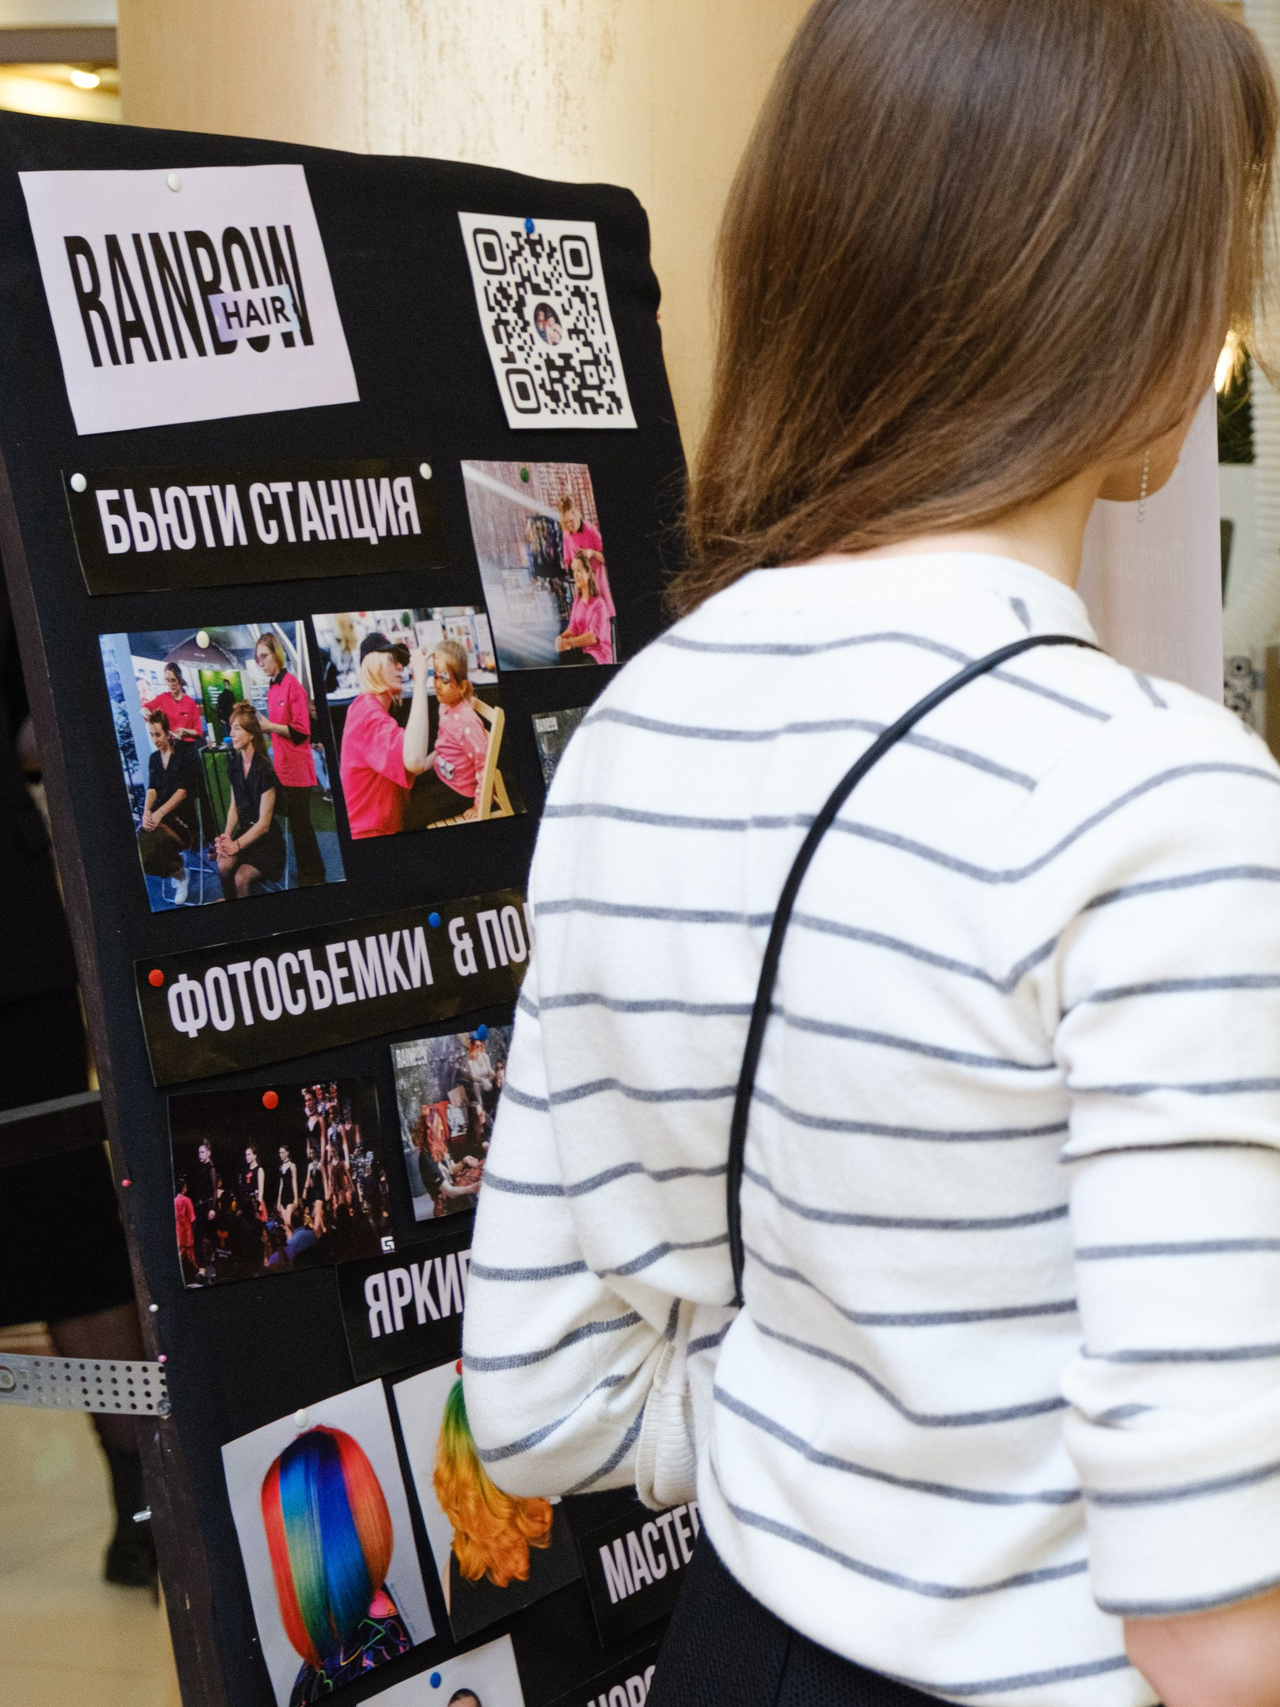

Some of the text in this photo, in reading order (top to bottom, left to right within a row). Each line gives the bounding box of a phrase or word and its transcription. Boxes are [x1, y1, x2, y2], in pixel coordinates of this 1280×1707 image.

[63, 225, 315, 368] RAINBOW
[221, 296, 291, 330] HAIR
[95, 476, 422, 554] БЬЮТИ СТАНЦИЯ
[167, 926, 434, 1038] ФОТОСЪЕМКИ
[448, 916, 478, 977] &
